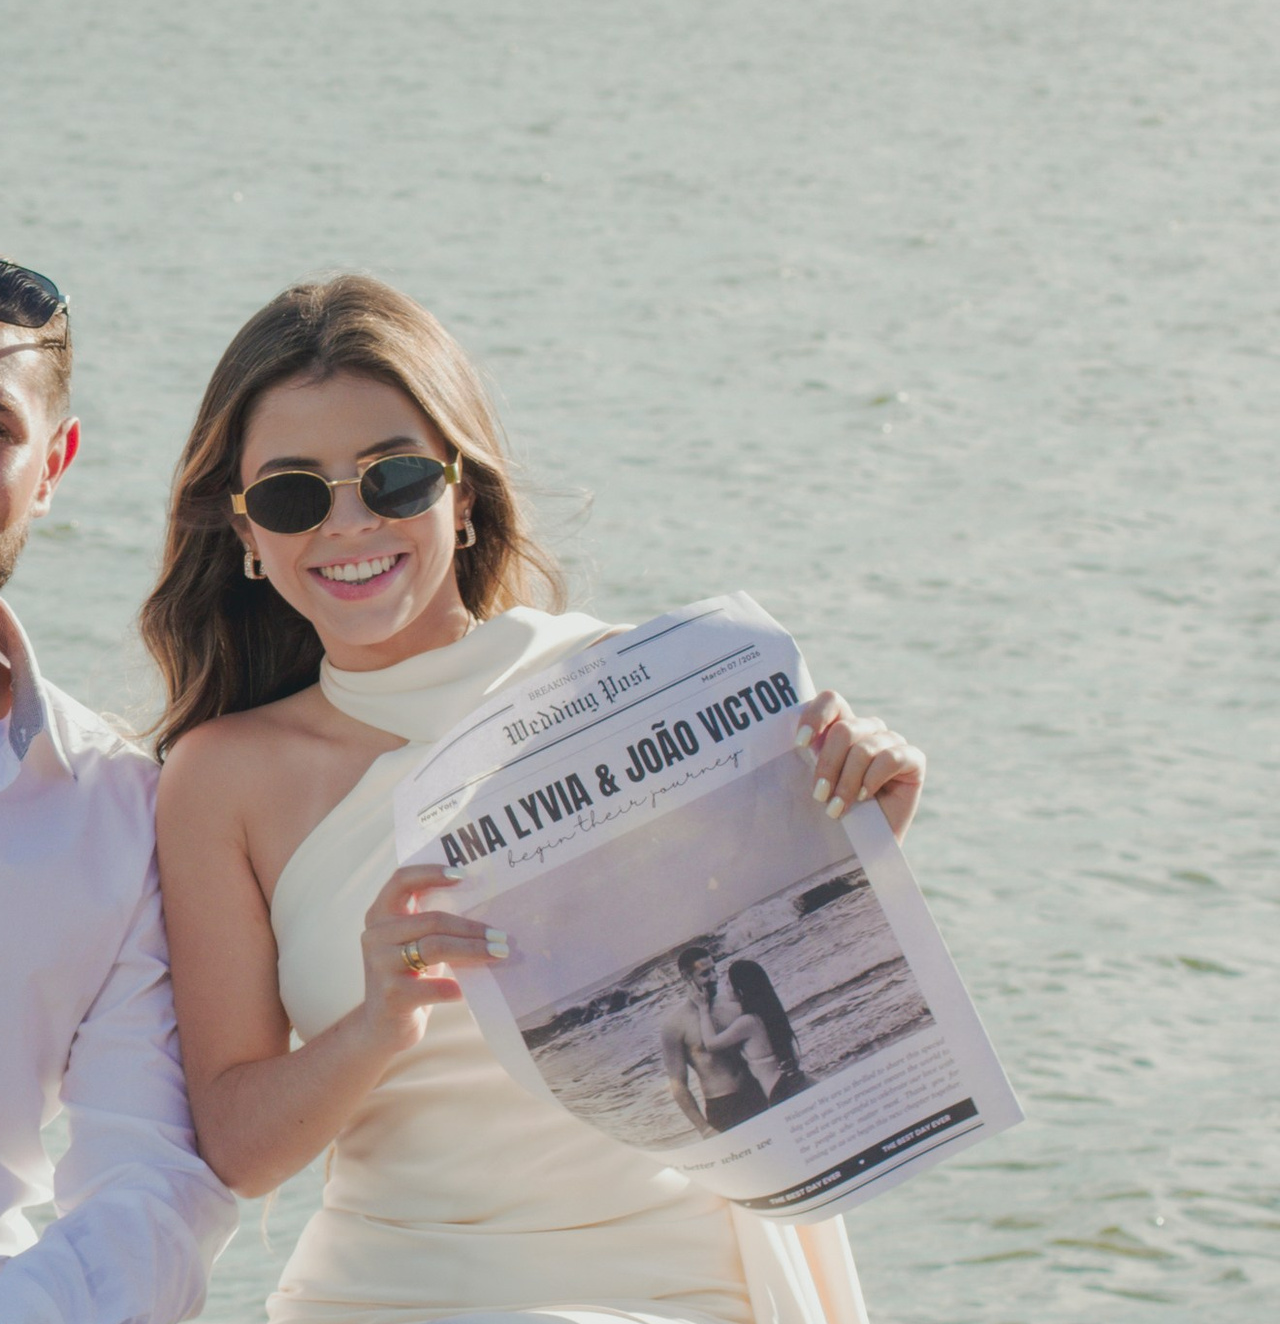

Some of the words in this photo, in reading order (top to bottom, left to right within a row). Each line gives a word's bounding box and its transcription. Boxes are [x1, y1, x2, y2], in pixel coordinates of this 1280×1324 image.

[528, 670, 578, 701] BREAKING
[577, 657, 607, 676] NEWS
[700, 665, 727, 683] March
[727, 661, 737, 671] 07
[502, 692, 600, 746] Wedding
[598, 662, 651, 704] Post
[440, 814, 508, 868] ANA
[504, 772, 594, 839] LYVIA
[595, 763, 622, 797] &
[626, 719, 700, 783] JOÃO
[696, 671, 799, 744] VICTOR
[421, 807, 438, 823] New
[438, 798, 458, 813] York
[508, 828, 576, 868] begin
[575, 796, 648, 833] their
[650, 748, 744, 808] journey
[721, 1148, 752, 1165] when
[756, 1138, 772, 1150] we
[881, 1141, 896, 1152] THE
[896, 1131, 913, 1145] BEST
[914, 1123, 930, 1136] DAY
[931, 1115, 951, 1128] EVER
[769, 1195, 786, 1205] THE
[785, 1188, 804, 1200] BEST
[805, 1180, 821, 1192] DAY
[821, 1171, 841, 1184] EVER
